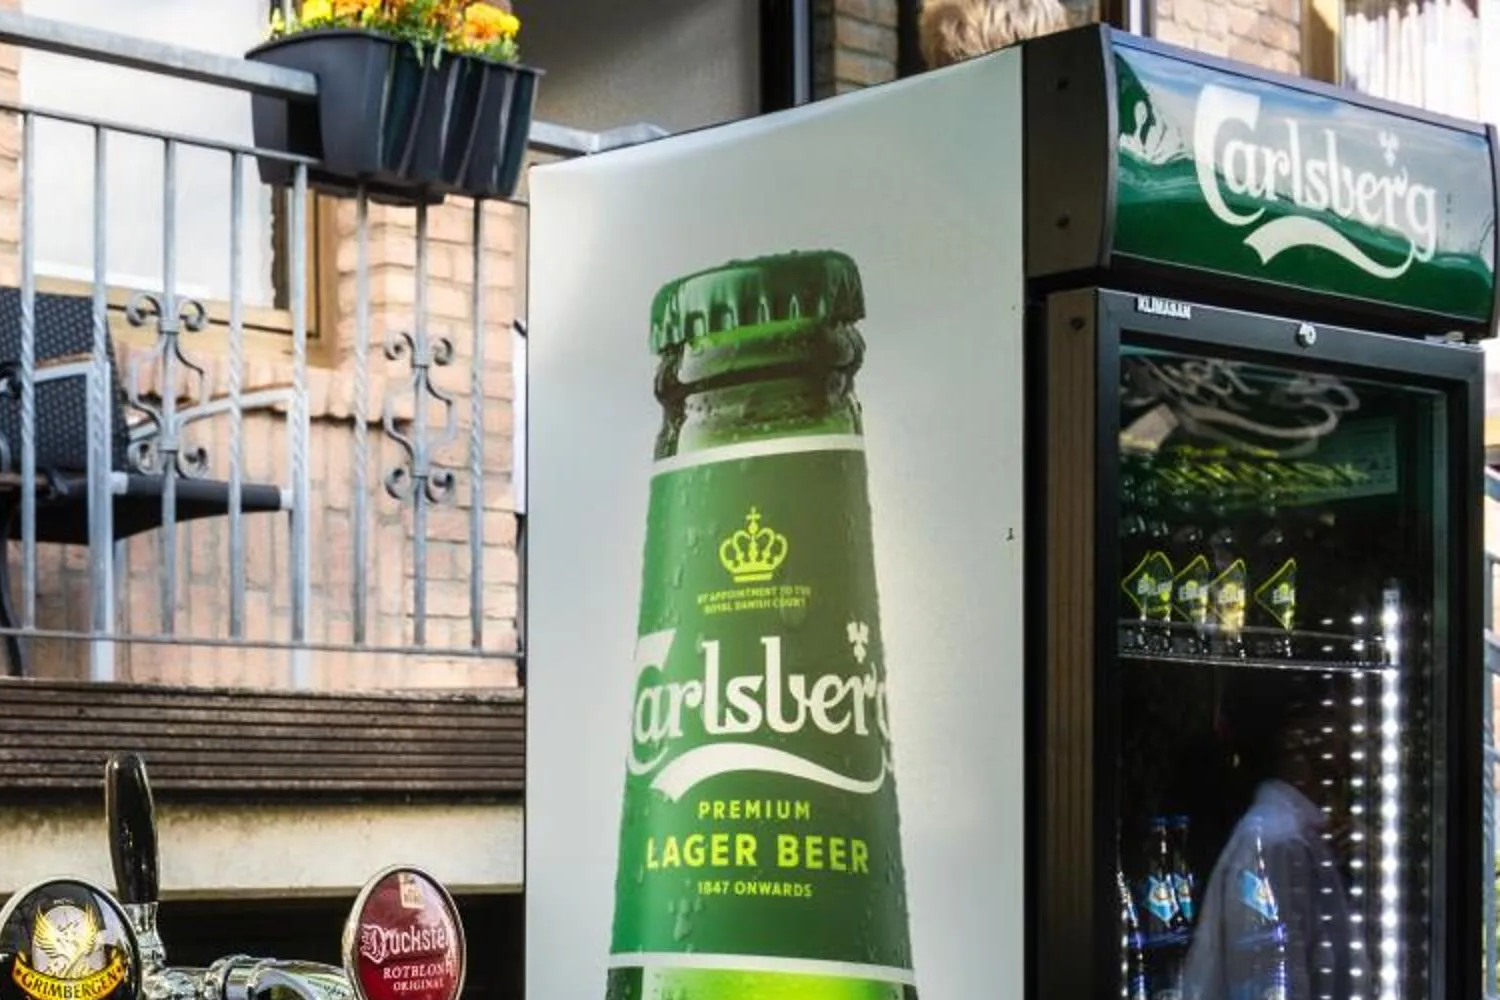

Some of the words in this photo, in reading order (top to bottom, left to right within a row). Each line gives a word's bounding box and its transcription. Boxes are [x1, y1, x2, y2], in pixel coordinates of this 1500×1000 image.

[1194, 84, 1437, 264] Carlsberg
[698, 799, 811, 820] PREMIUM
[647, 833, 757, 869] LAGER
[777, 834, 869, 875] BEER
[698, 881, 730, 895] 1847
[734, 881, 813, 898] ONWARDS
[360, 924, 448, 964] Duckste
[21, 970, 118, 999] GRIMBERGEN
[383, 963, 452, 980] ROTBLON
